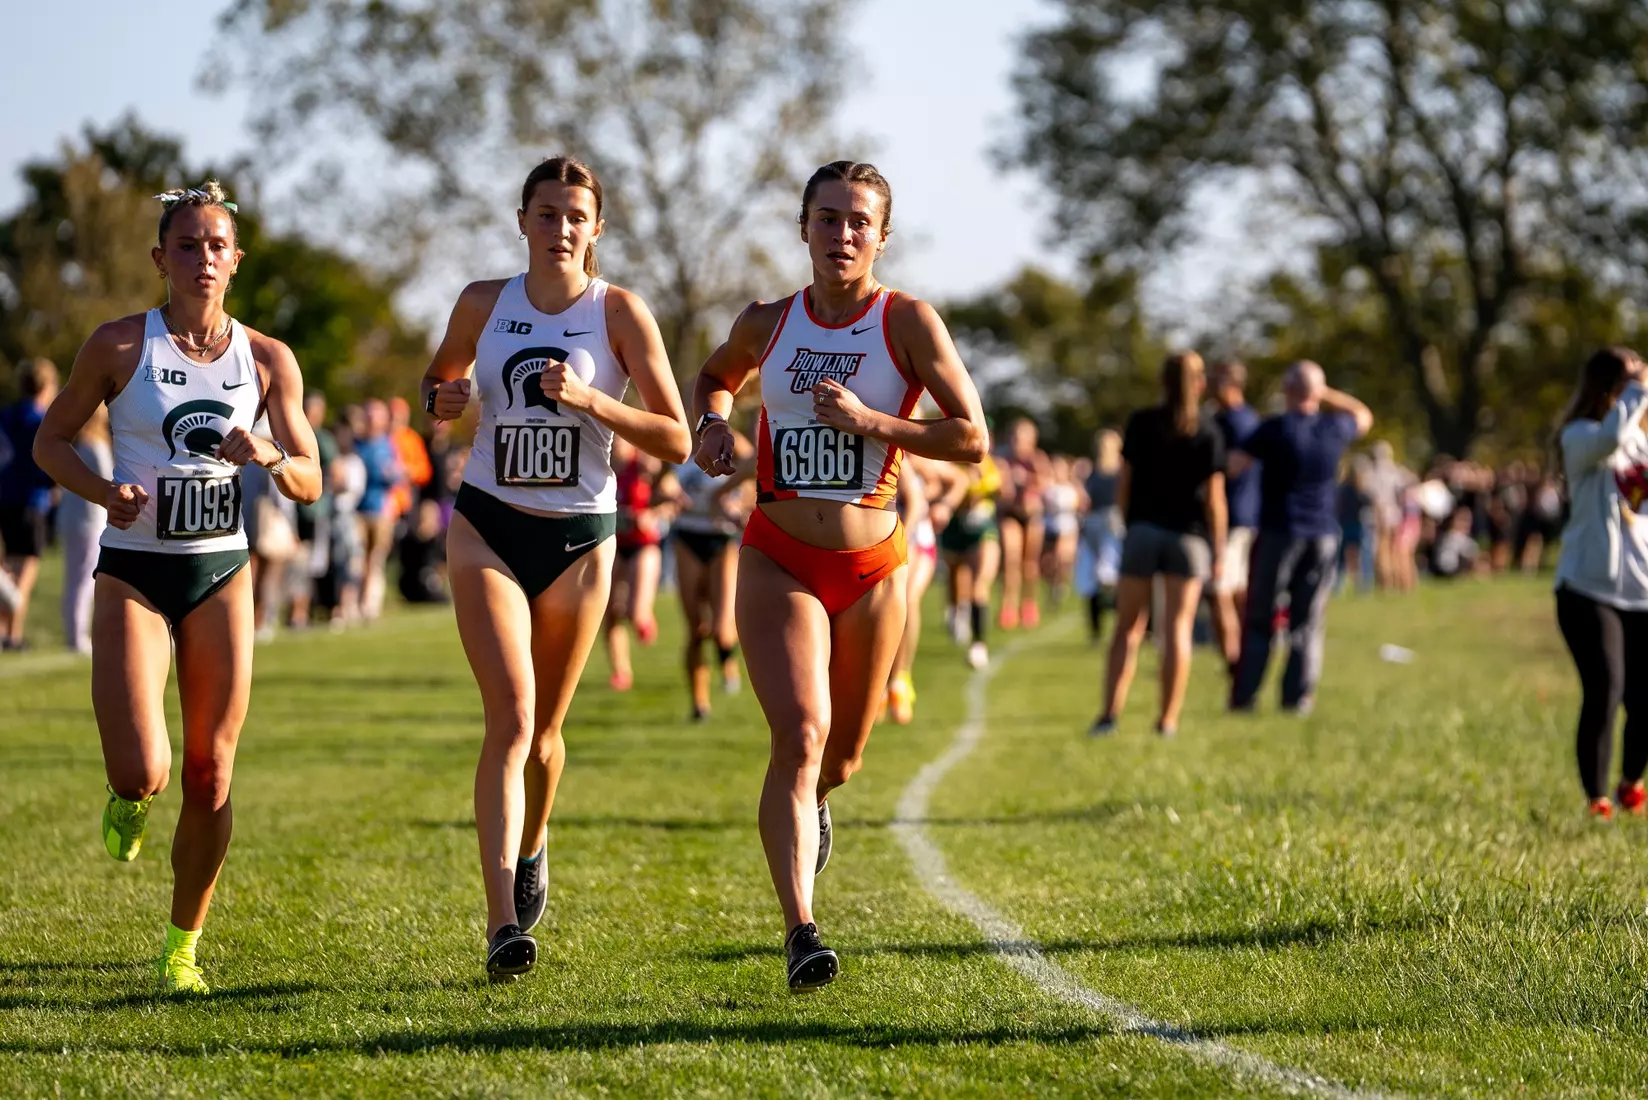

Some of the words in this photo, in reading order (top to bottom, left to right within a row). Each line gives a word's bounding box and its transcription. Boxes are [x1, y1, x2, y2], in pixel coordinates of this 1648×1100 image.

[500, 427, 572, 479] 7089
[780, 428, 855, 481] 6966
[164, 478, 235, 531] 7093
